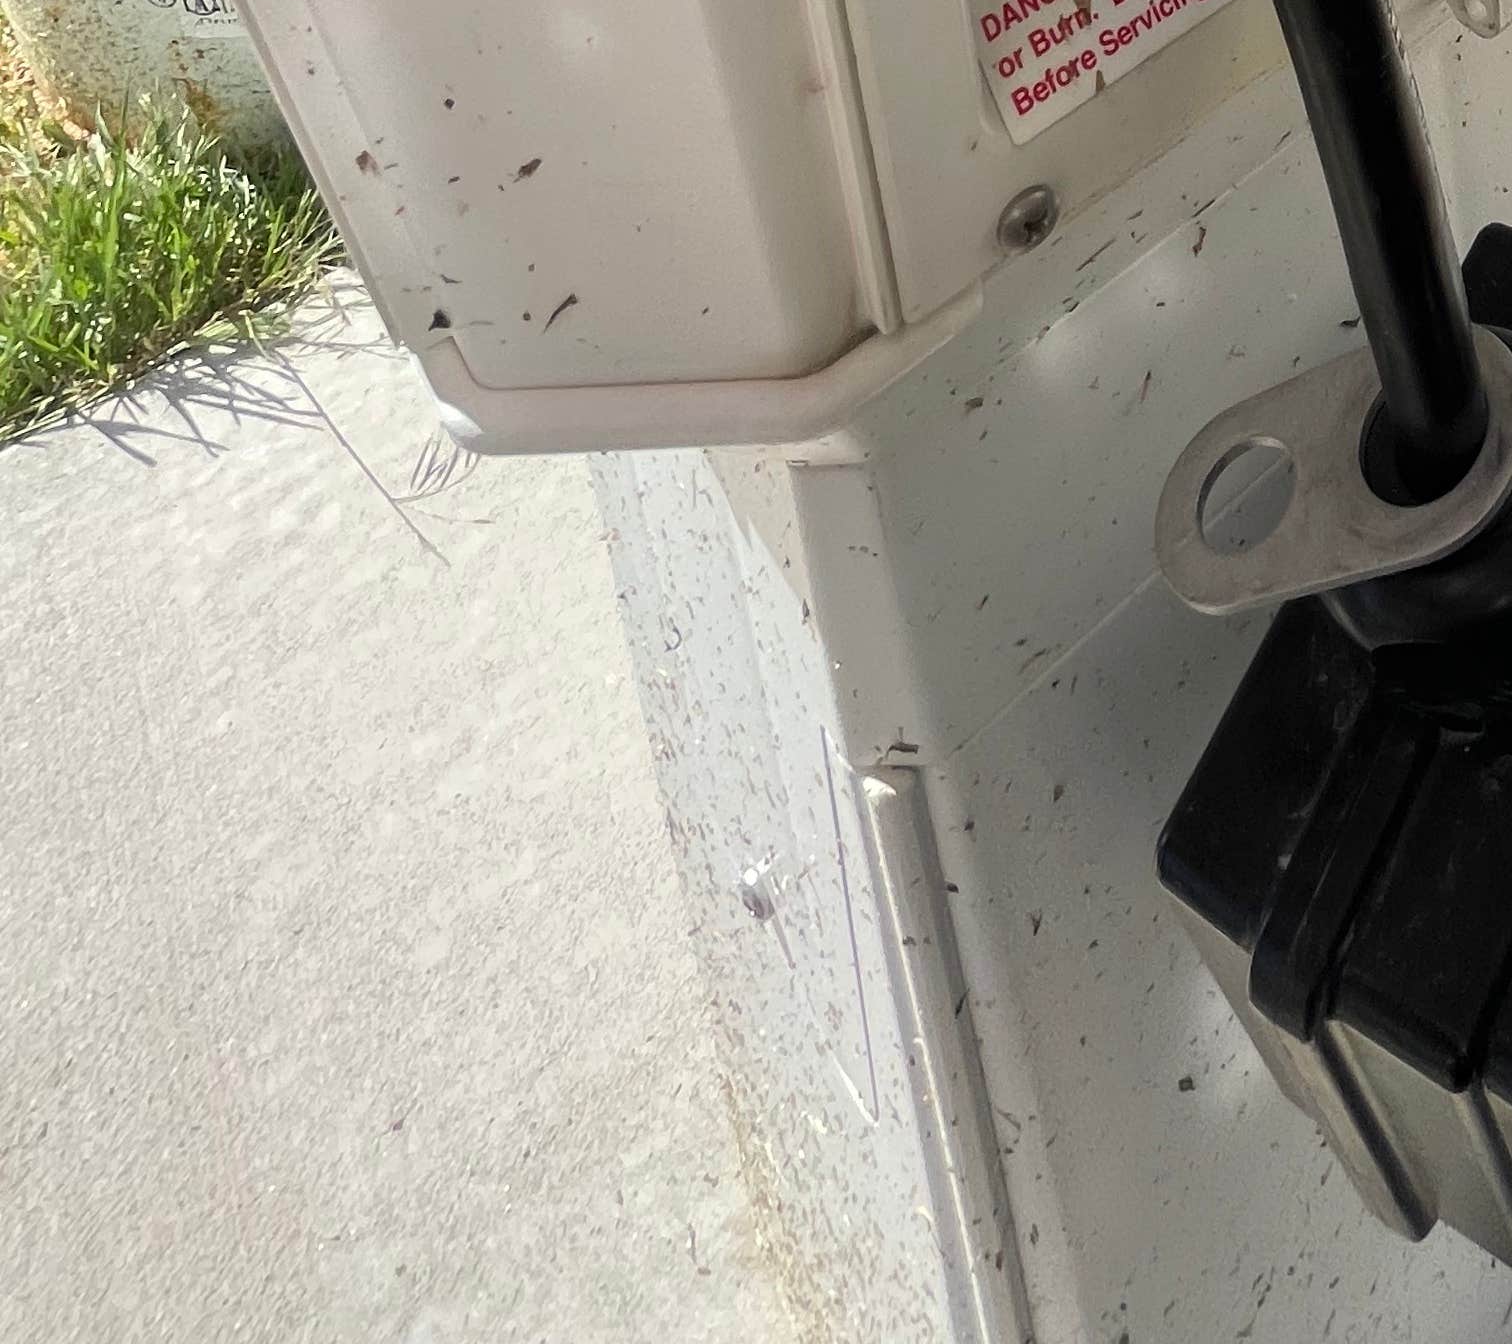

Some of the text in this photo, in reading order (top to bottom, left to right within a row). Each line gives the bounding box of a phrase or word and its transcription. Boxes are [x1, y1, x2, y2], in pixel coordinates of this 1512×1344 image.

[998, 46, 1025, 79] or
[1027, 6, 1100, 58] Burn.
[1010, 48, 1098, 116] Before
